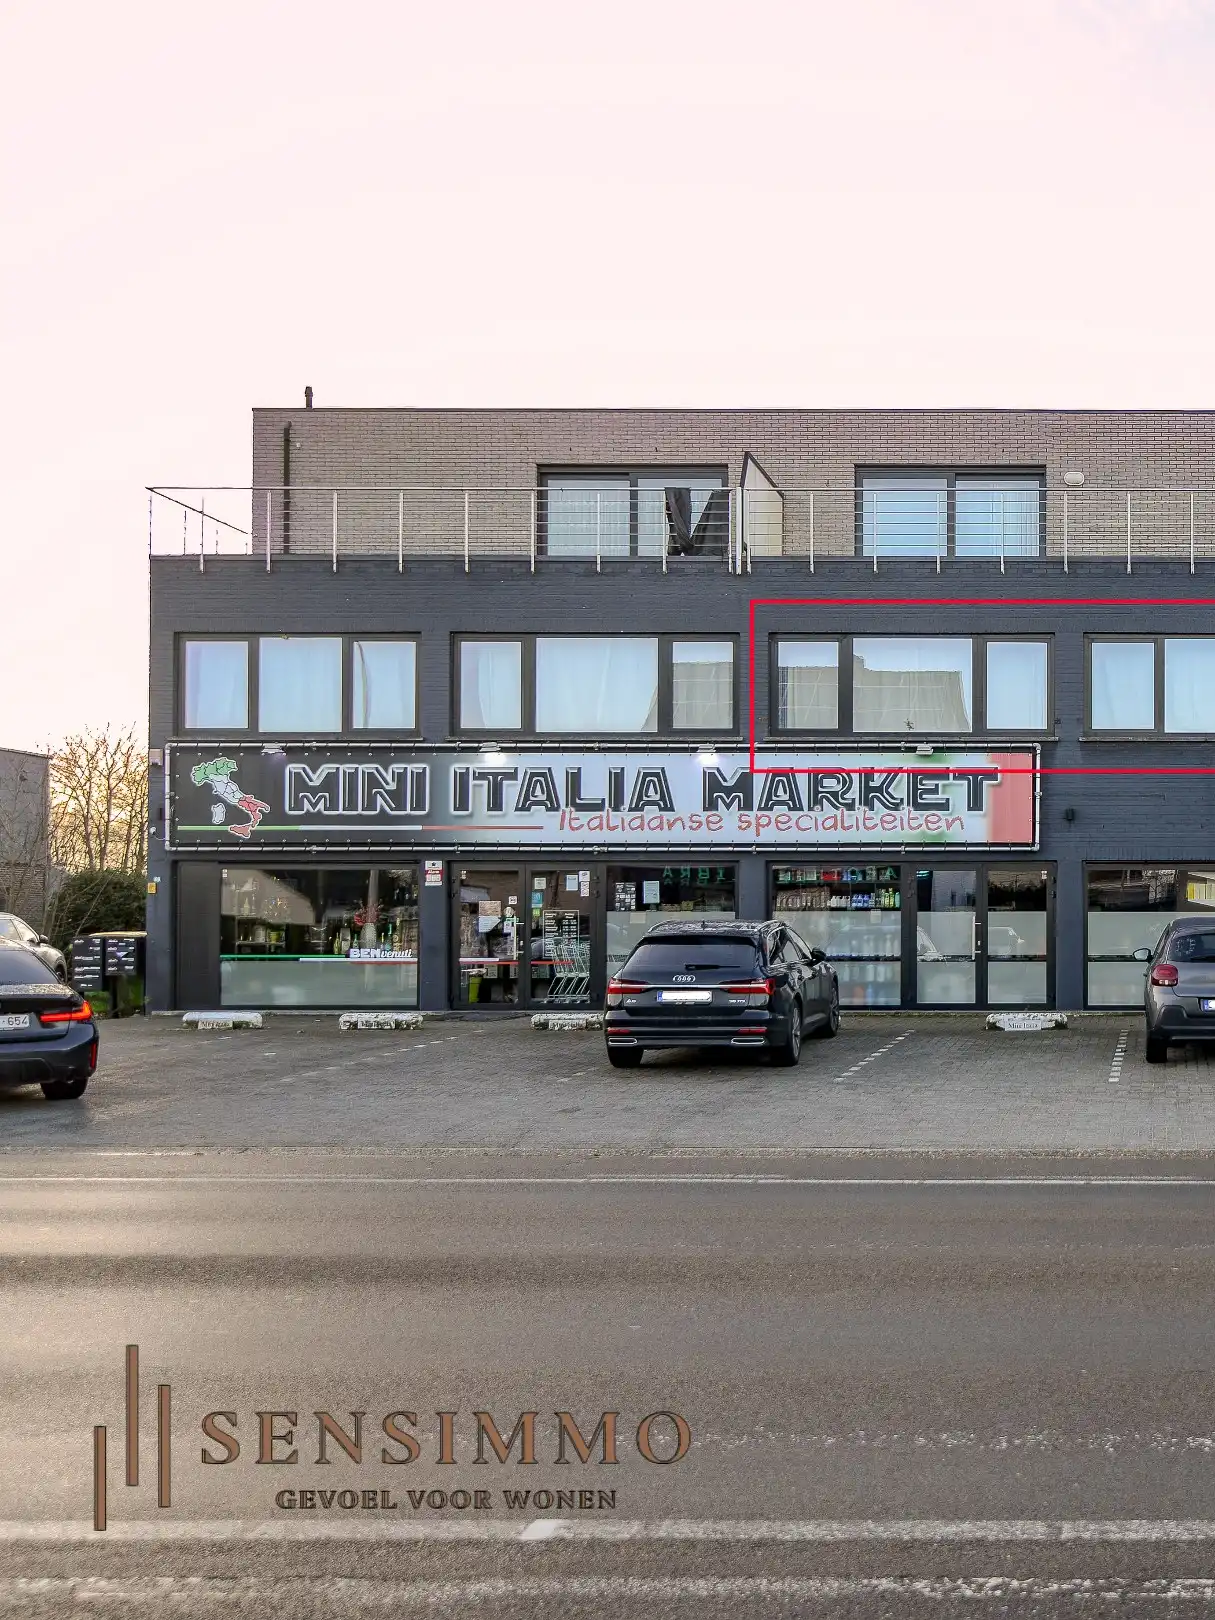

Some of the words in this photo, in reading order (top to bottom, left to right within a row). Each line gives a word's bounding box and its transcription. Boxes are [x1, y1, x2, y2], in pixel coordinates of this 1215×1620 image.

[287, 764, 429, 814] MINI
[453, 765, 676, 813] ITALIA
[701, 766, 1000, 813] MARKET
[559, 808, 725, 833] Italiaanse
[737, 806, 965, 837] specialiteiten
[7, 1016, 28, 1026] 654
